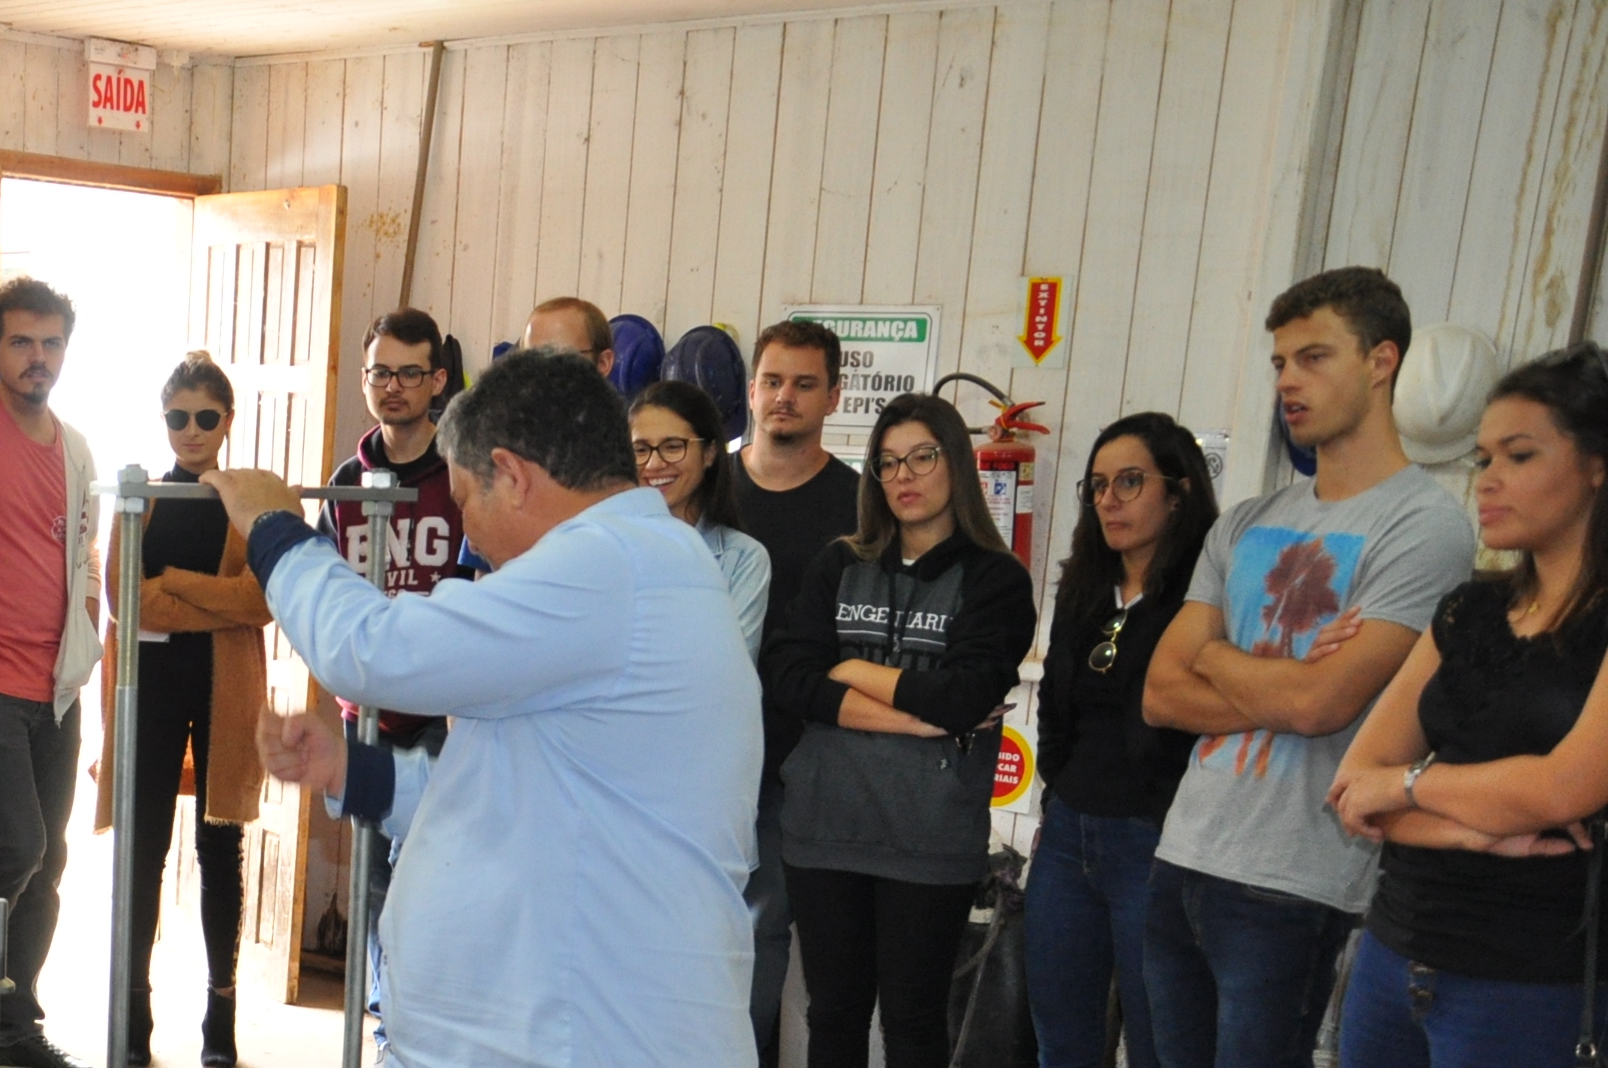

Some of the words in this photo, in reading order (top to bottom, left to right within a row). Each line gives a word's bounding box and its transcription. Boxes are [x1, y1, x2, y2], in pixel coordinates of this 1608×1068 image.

[92, 68, 146, 115] SAÍDA
[1033, 283, 1049, 346] EXTINTOR
[812, 317, 918, 342] GURANÇA
[840, 371, 915, 393] GATÓRIO
[387, 569, 418, 587] VIL
[998, 752, 1021, 762] IDO
